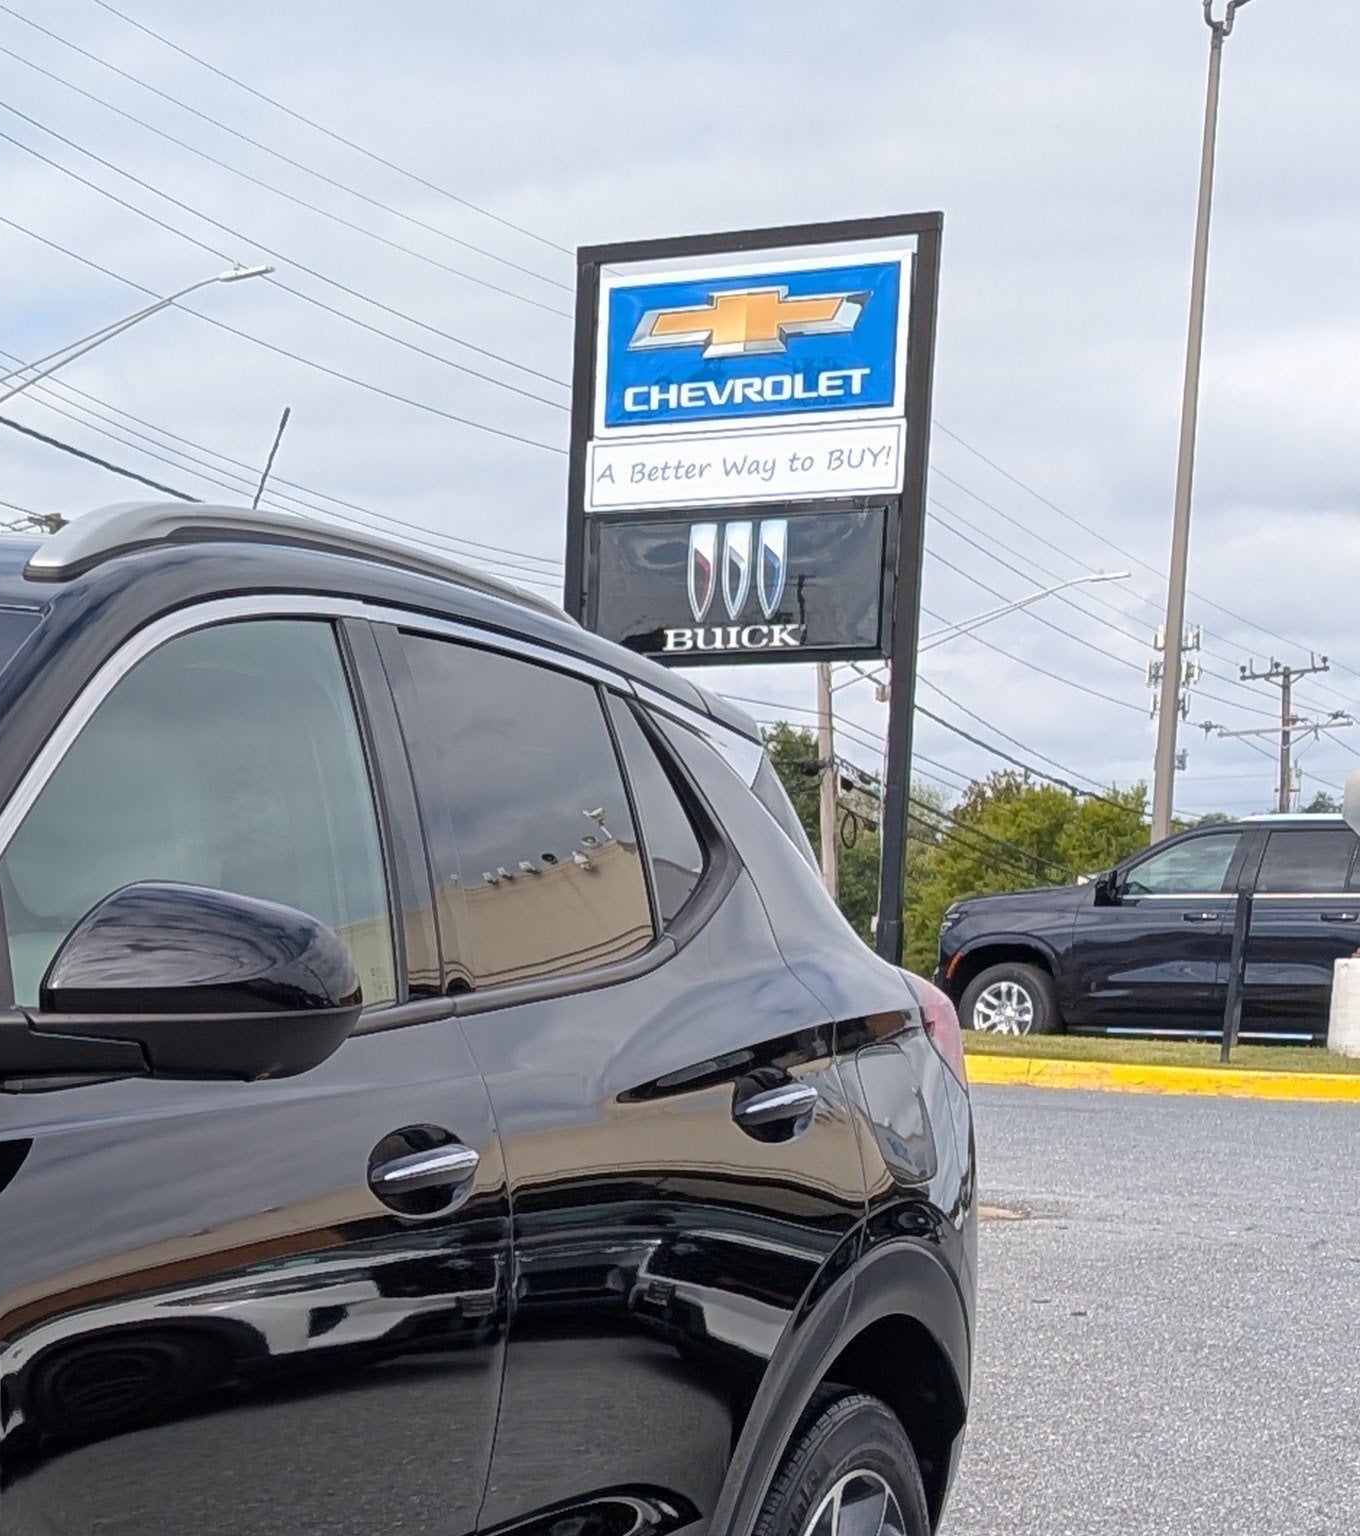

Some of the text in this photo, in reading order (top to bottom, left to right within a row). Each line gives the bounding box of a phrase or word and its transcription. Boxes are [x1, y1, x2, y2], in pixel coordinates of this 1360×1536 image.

[623, 368, 871, 413] CHEVROLET
[596, 445, 893, 484] A Better Way to BUY!
[663, 623, 802, 652] BUICK
